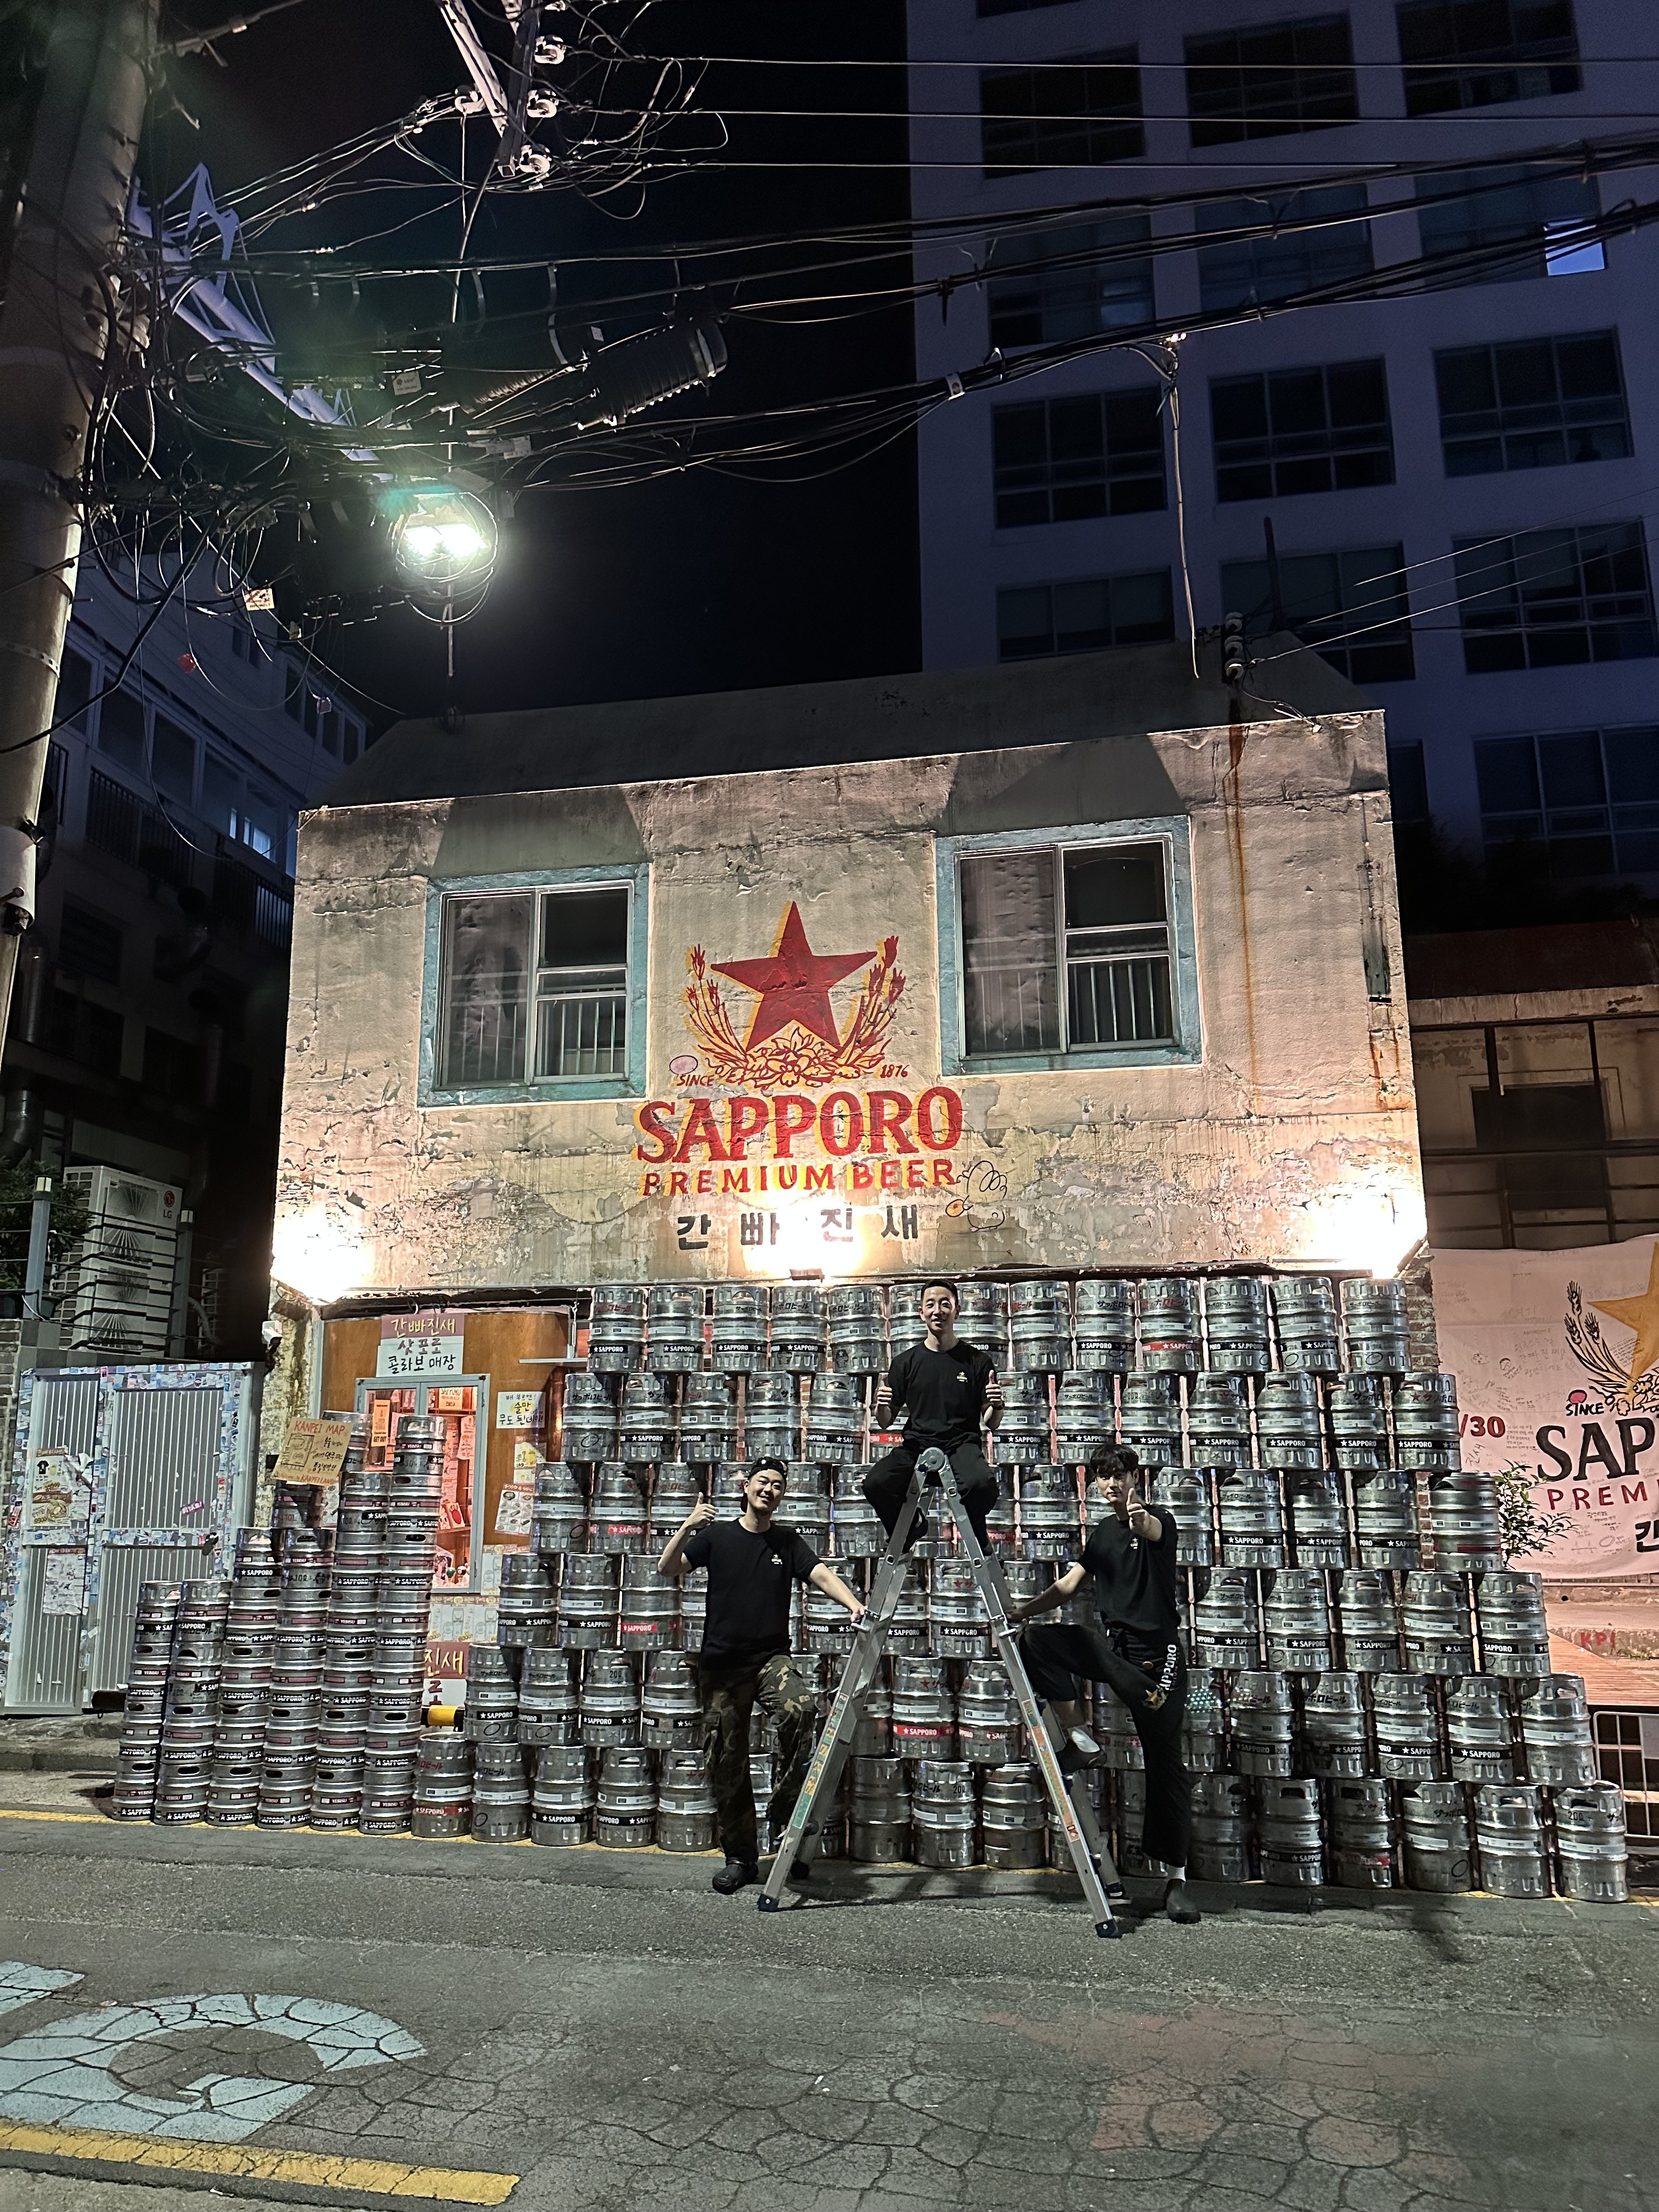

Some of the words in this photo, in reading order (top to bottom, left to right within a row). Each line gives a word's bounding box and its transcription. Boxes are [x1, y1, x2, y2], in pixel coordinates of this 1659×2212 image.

[880, 1064, 909, 1079] 1876
[676, 1075, 714, 1087] SINCE
[637, 1086, 964, 1164] SAPPORO
[644, 1163, 836, 1197] PREMIUM
[853, 1159, 958, 1190] BEER
[163, 1210, 173, 1219] LG
[391, 1317, 456, 1339] 간빠진새
[388, 1355, 424, 1374] 콜라보
[429, 1354, 456, 1371] 매장
[514, 1402, 531, 1414] 술만
[1566, 1402, 1605, 1417] SINCE
[294, 1420, 323, 1433] KANPEI
[326, 1424, 345, 1436] MAP
[1547, 1480, 1659, 1511] PREM
[1241, 1744, 1269, 1753] SAPPORO
